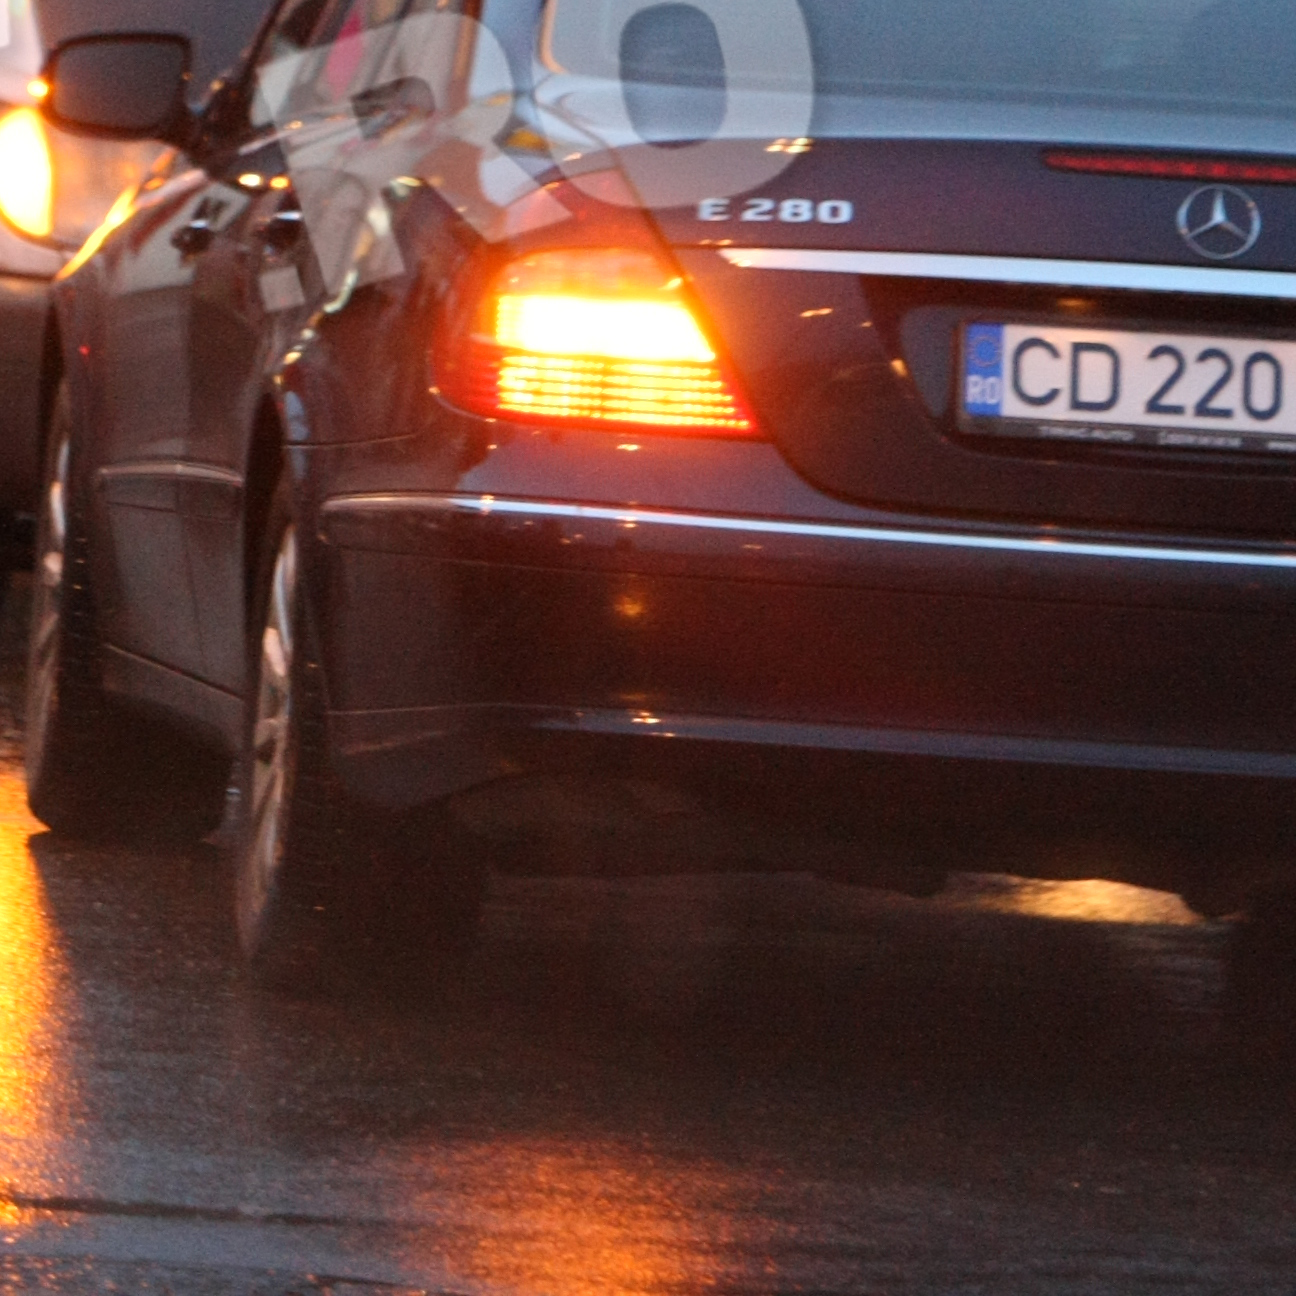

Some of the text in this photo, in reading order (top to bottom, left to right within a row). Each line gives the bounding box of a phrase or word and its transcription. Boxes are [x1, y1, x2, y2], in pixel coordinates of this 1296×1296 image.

[696, 198, 854, 225] E 280
[967, 375, 1001, 404] RO
[1012, 336, 1284, 422] CD 220
